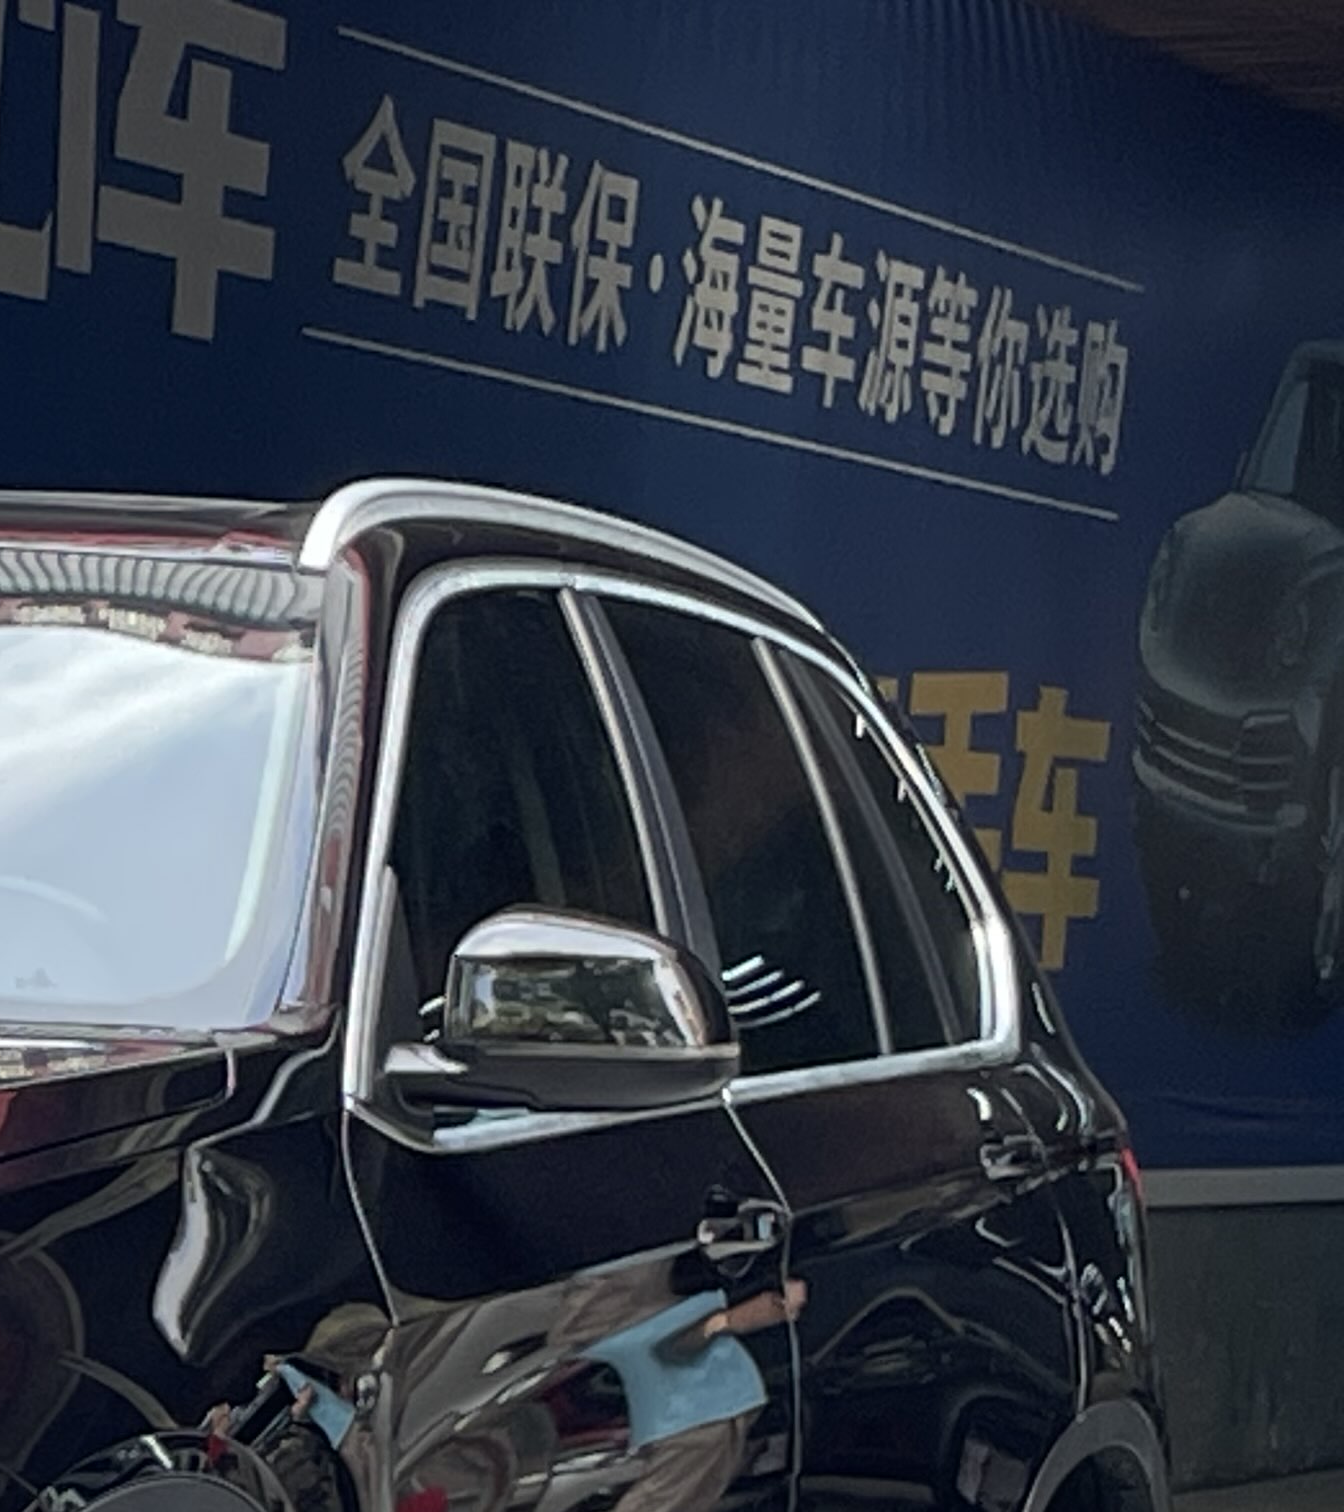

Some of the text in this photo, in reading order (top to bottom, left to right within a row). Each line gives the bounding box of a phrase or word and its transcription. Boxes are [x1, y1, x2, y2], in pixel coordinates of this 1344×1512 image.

[332, 94, 1129, 476] 全国联保·海量车源等你选购
